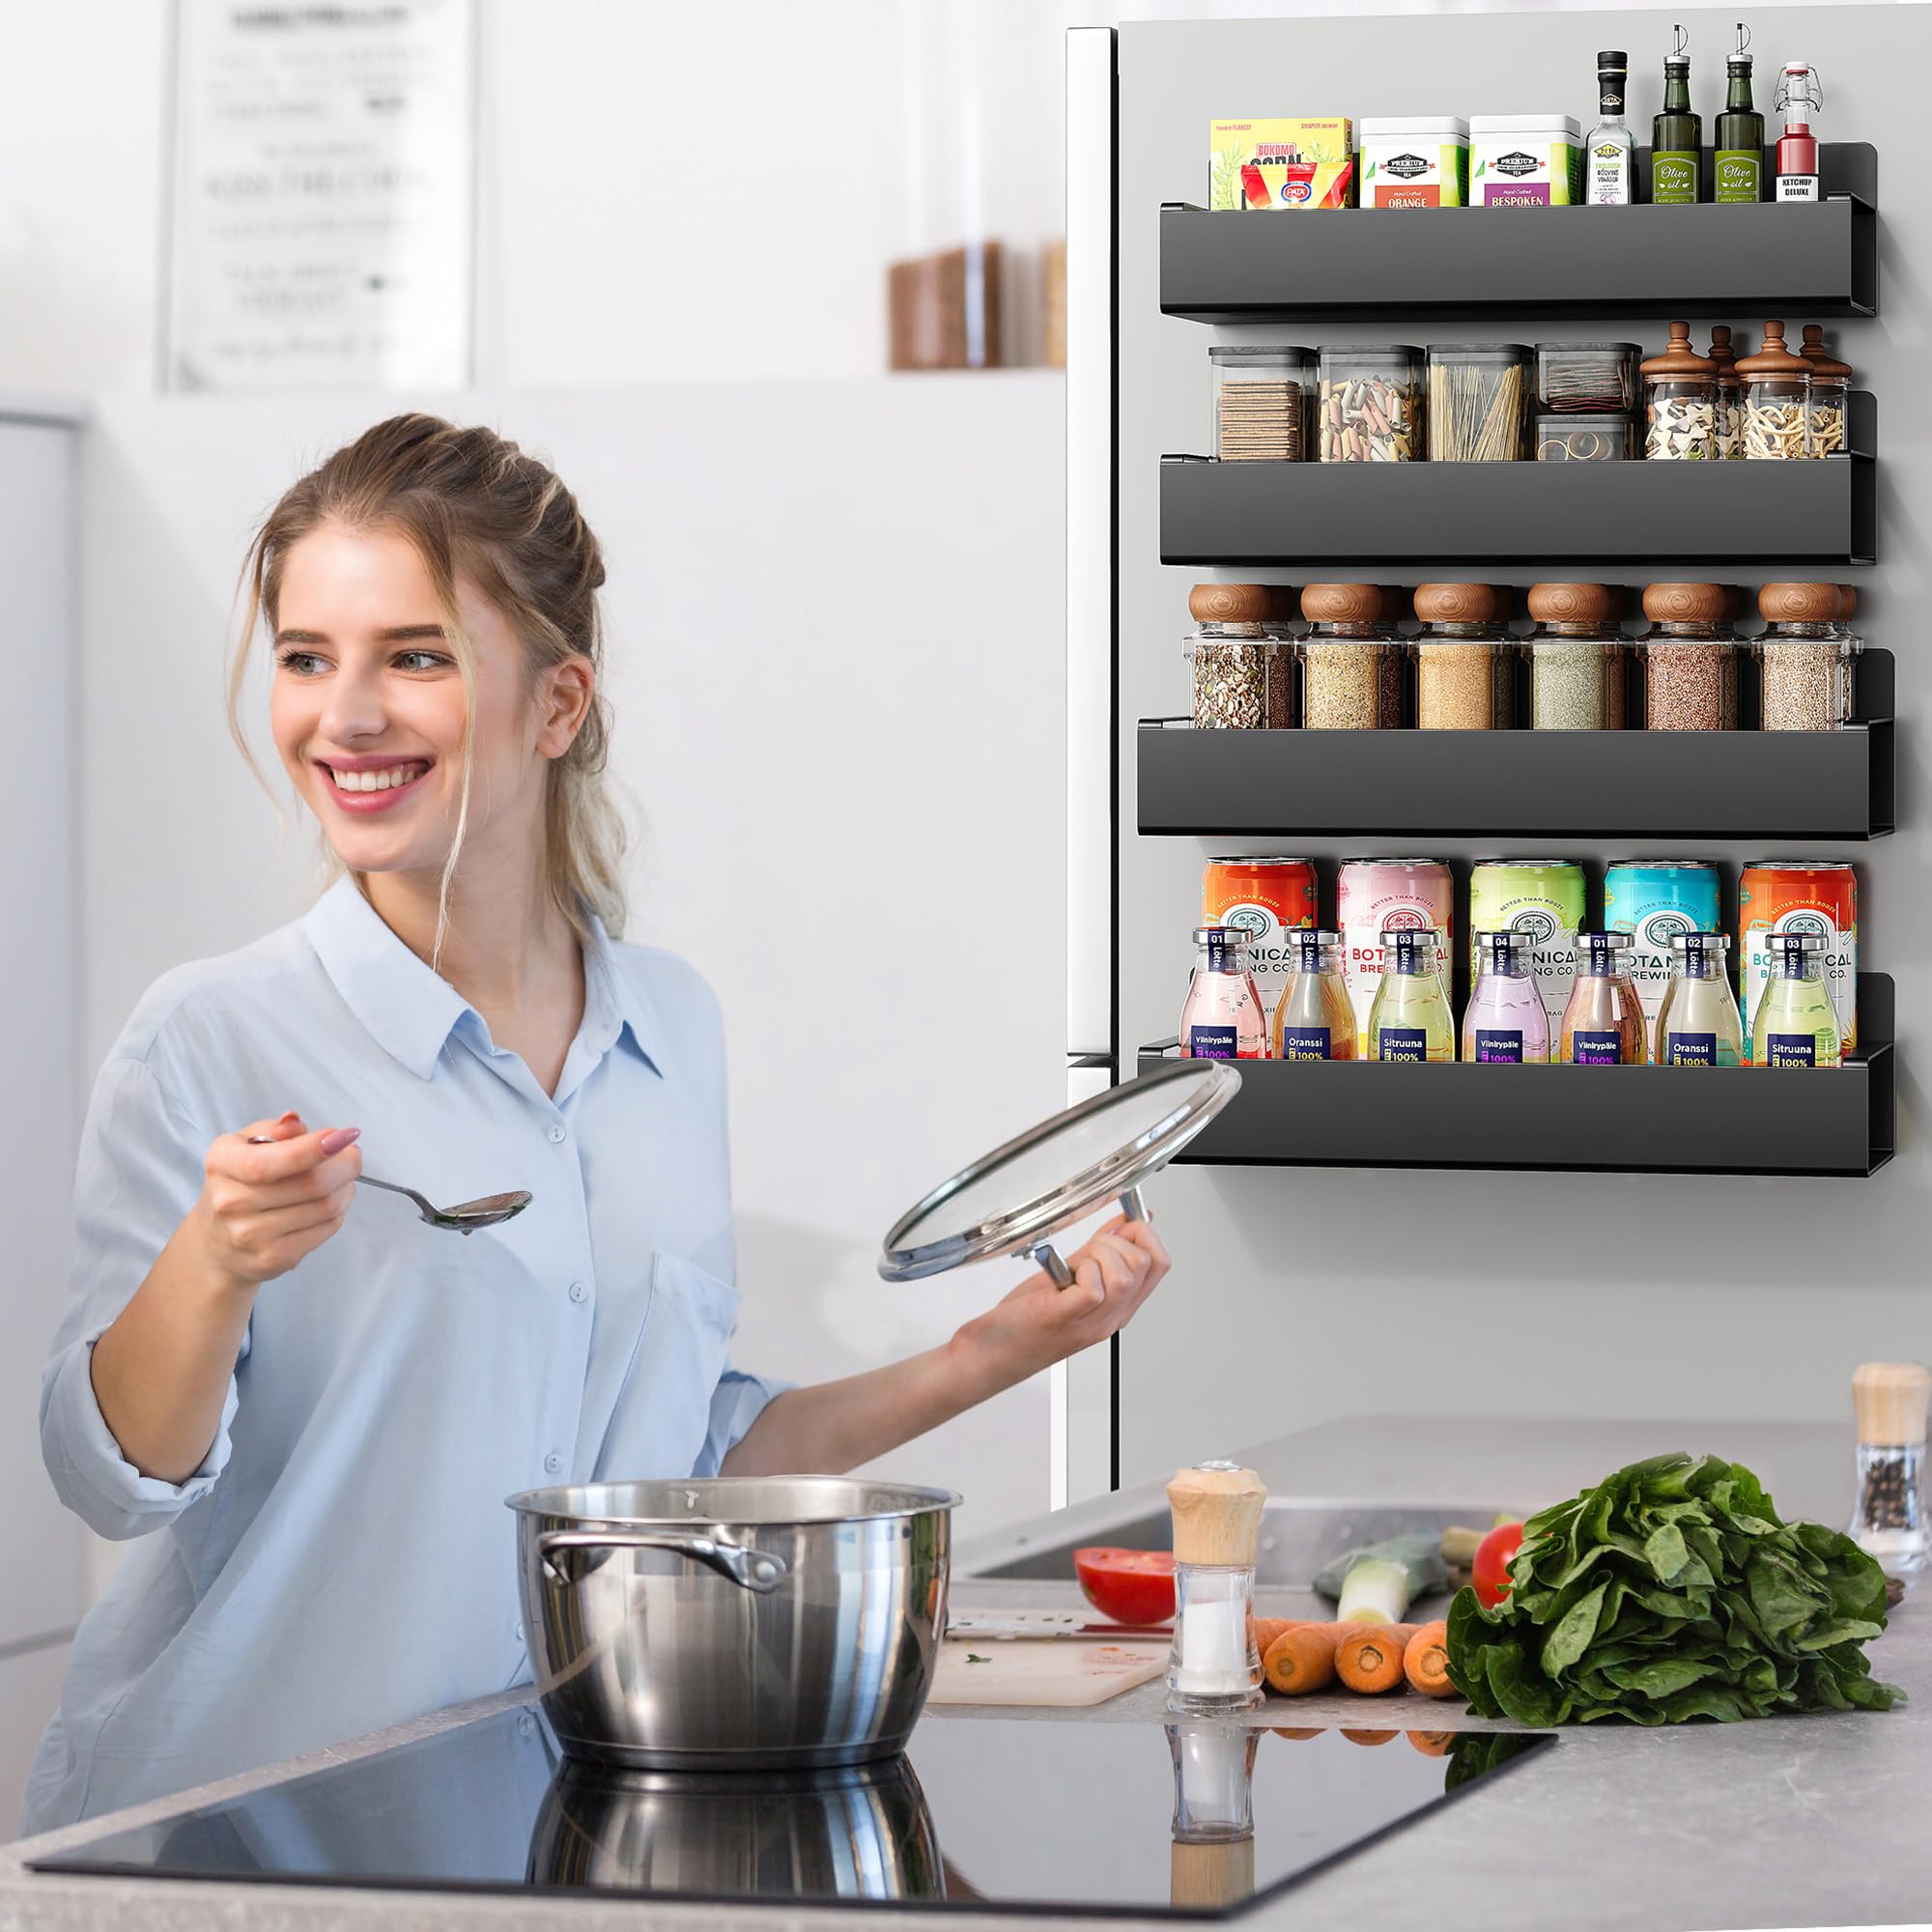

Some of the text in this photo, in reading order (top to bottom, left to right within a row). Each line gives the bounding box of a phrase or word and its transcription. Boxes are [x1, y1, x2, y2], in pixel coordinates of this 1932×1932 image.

[1258, 144, 1294, 156] BOKOMO
[1661, 165, 1688, 179] Olive
[1723, 164, 1751, 178] Olive
[1667, 179, 1679, 189] oil
[1729, 178, 1743, 189] oil
[1782, 178, 1812, 186] KETCHUP
[1785, 188, 1809, 196] DELUXE
[1388, 198, 1427, 208] ORANGE
[1492, 196, 1543, 206] BESPOKEN
[1259, 896, 1280, 908] BOOZE
[1415, 896, 1435, 909] BOOZE
[1545, 898, 1564, 910] BOOZE
[1817, 901, 1836, 913] BOOZE
[1679, 902, 1699, 914] BOOZE
[1211, 935, 1223, 943] 01
[1303, 934, 1316, 943] 02
[1399, 936, 1411, 944] 03
[1495, 938, 1508, 946] 04
[1593, 939, 1605, 948] 01
[1688, 939, 1701, 948] 02
[1787, 940, 1800, 949] 03
[1289, 1037, 1323, 1048] Oranssi
[1384, 1038, 1422, 1048] Sitruuna
[1674, 1043, 1709, 1053] Oranssi
[1772, 1044, 1812, 1054] Sitruuna
[1205, 1051, 1230, 1059] 100%
[1392, 1052, 1419, 1062] 100%
[1683, 1058, 1709, 1066] 100%
[1781, 1058, 1808, 1067] 100%
